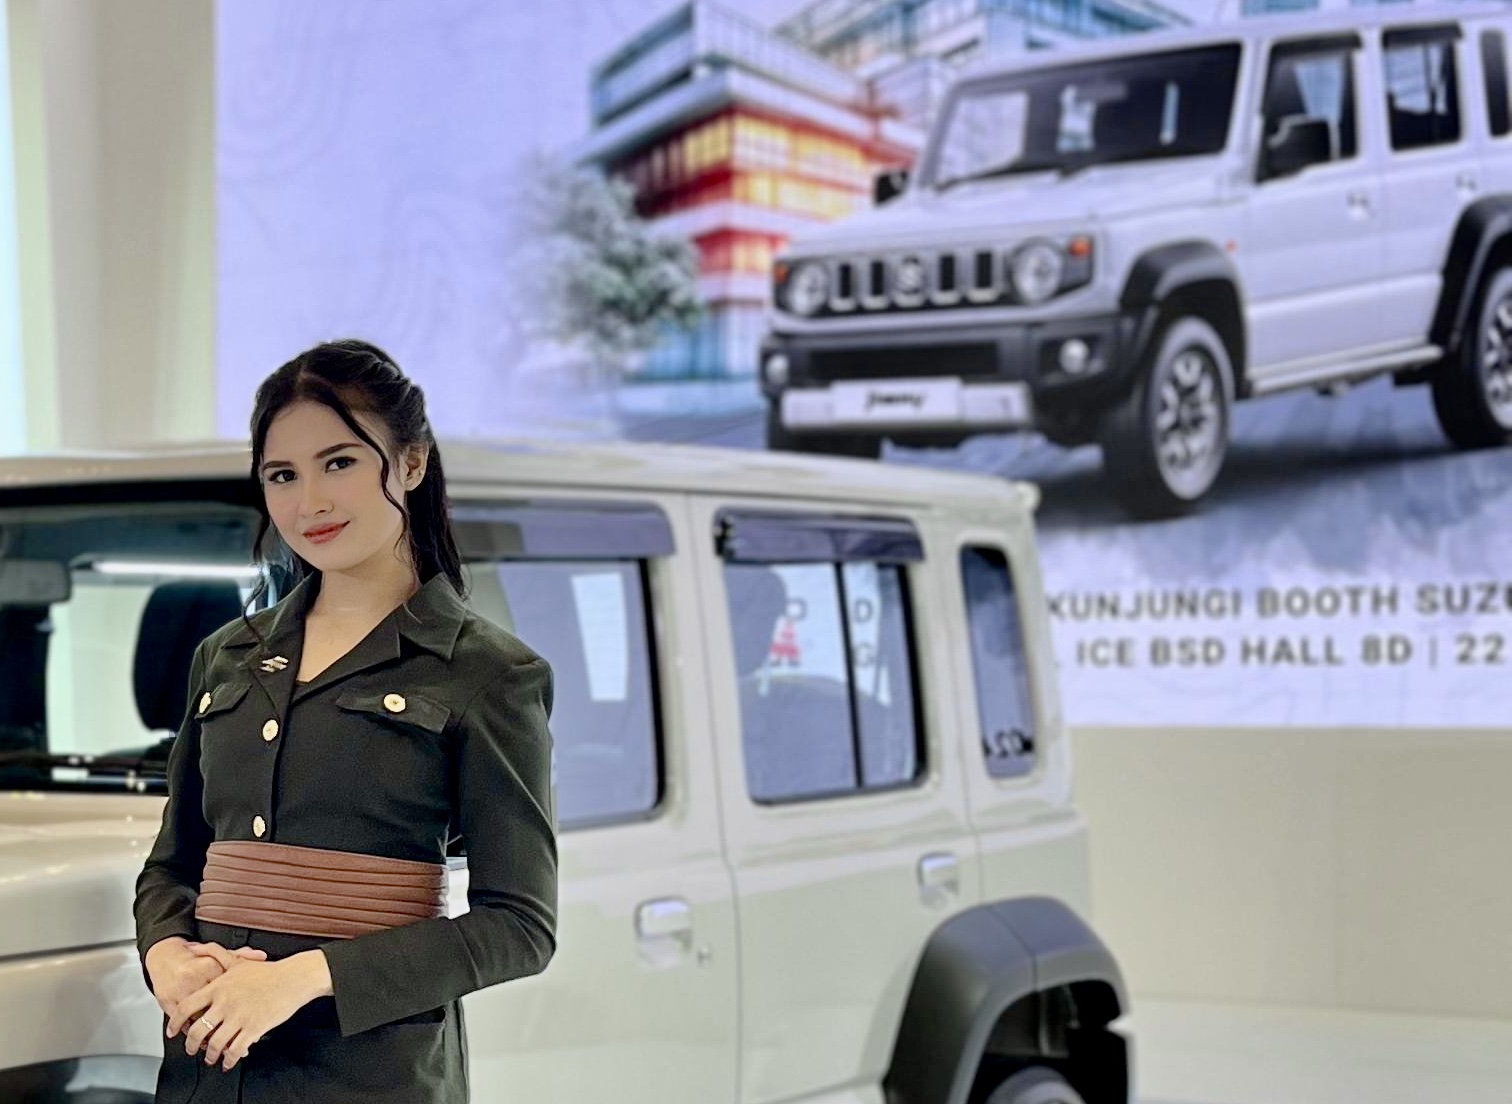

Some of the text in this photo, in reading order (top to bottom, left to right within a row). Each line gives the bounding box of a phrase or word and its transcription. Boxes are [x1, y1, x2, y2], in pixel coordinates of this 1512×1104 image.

[1045, 588, 1242, 621] KUNJUNGI
[1256, 585, 1399, 618] BOOTH
[1076, 639, 1135, 667] ICE
[1149, 637, 1226, 667] BSD
[1240, 636, 1343, 667] HALL
[1361, 634, 1413, 666] 8D
[1455, 633, 1505, 665] 22
